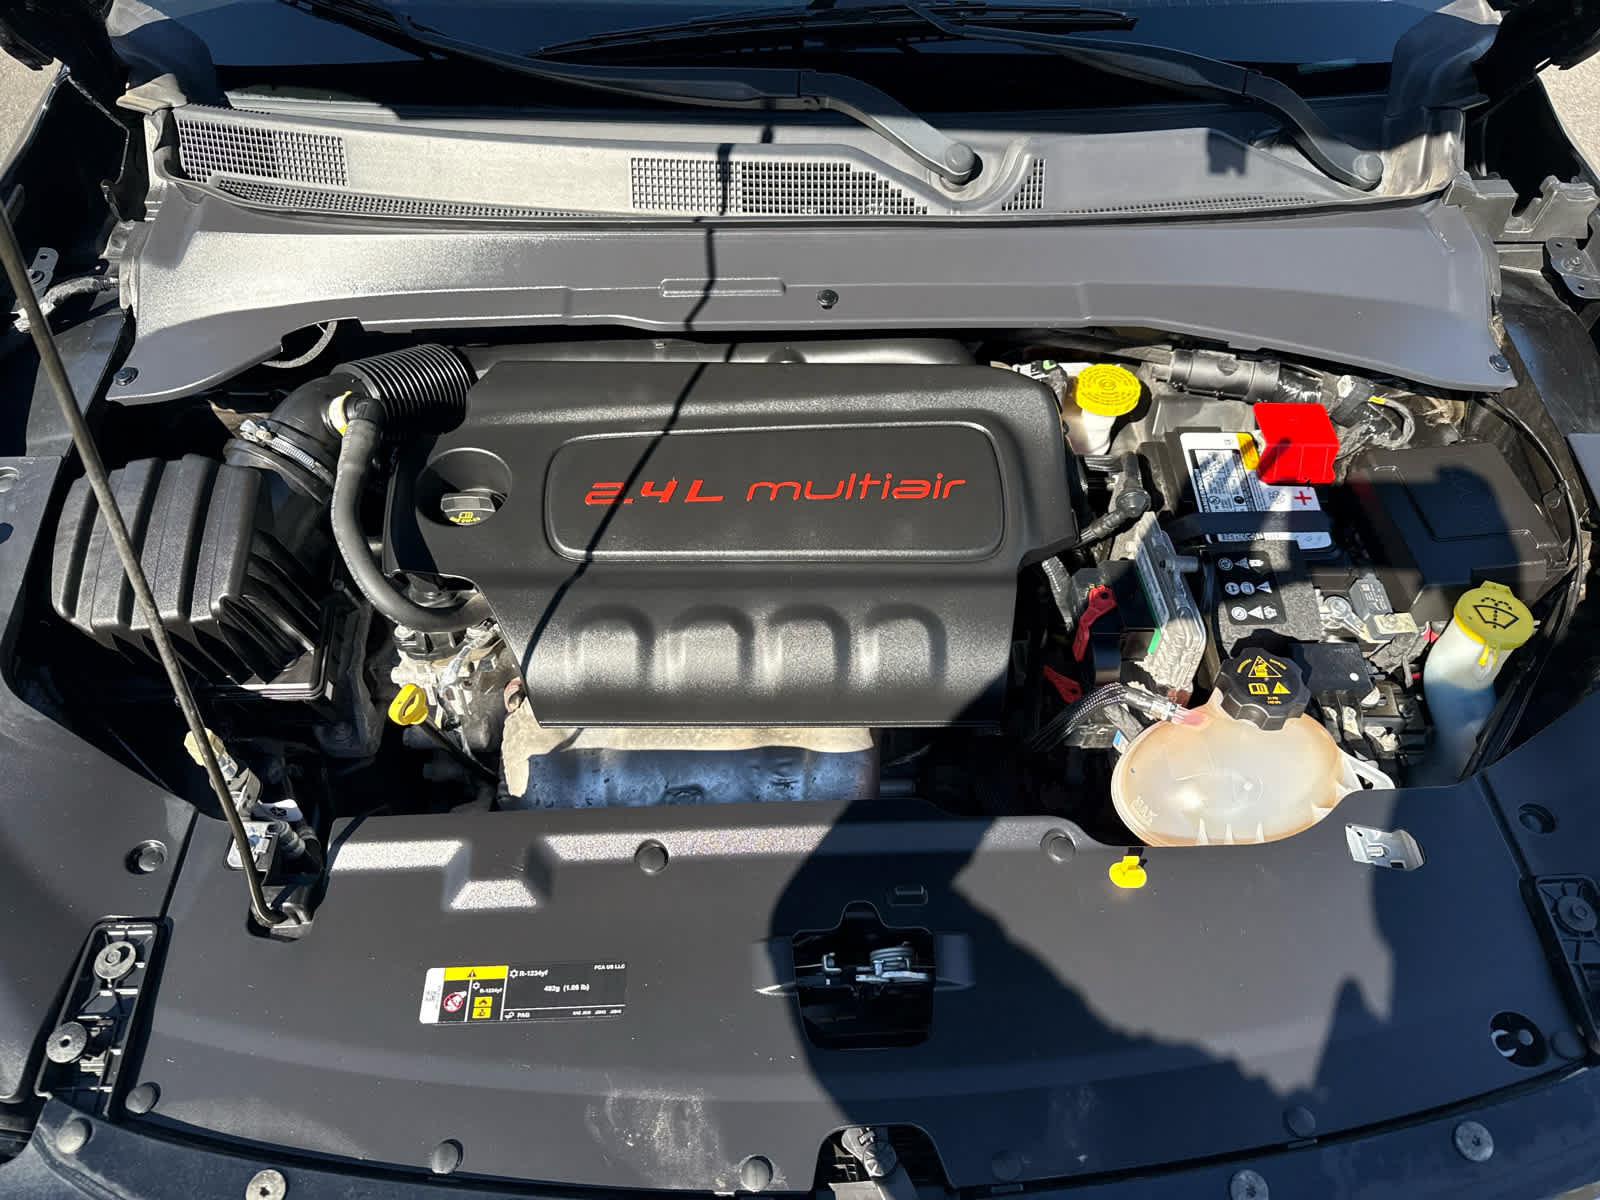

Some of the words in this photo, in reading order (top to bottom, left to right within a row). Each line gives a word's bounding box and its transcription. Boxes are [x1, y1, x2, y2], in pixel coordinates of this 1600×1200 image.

[584, 480, 724, 505] 2.4L
[746, 473, 966, 501] multiair
[519, 969, 549, 978] R-1234yf
